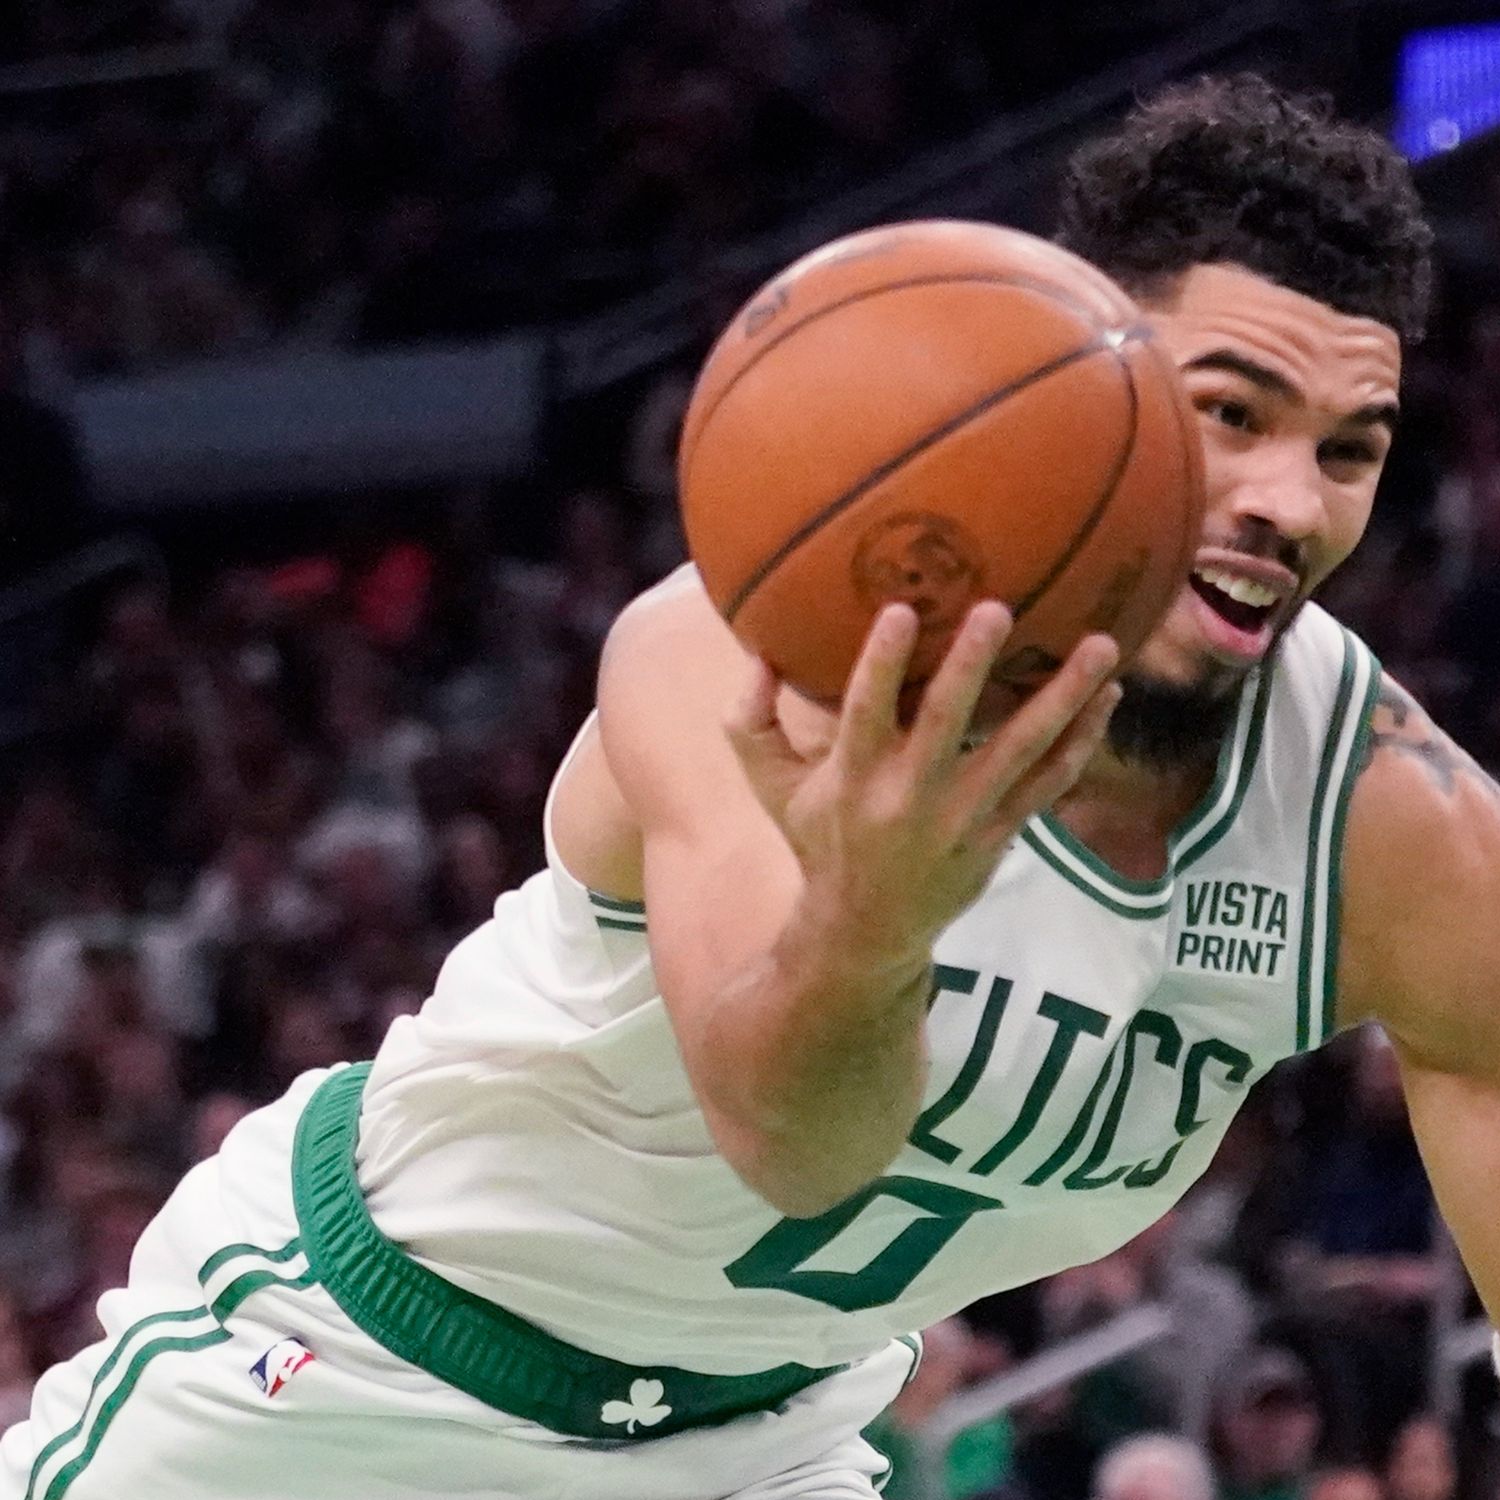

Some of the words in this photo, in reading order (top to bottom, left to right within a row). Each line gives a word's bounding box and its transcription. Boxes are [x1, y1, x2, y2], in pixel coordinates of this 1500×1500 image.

[1176, 932, 1286, 977] PRINT
[1186, 881, 1288, 940] VISTA
[906, 963, 1255, 1191] LTICS
[723, 1175, 1006, 1314] 0
